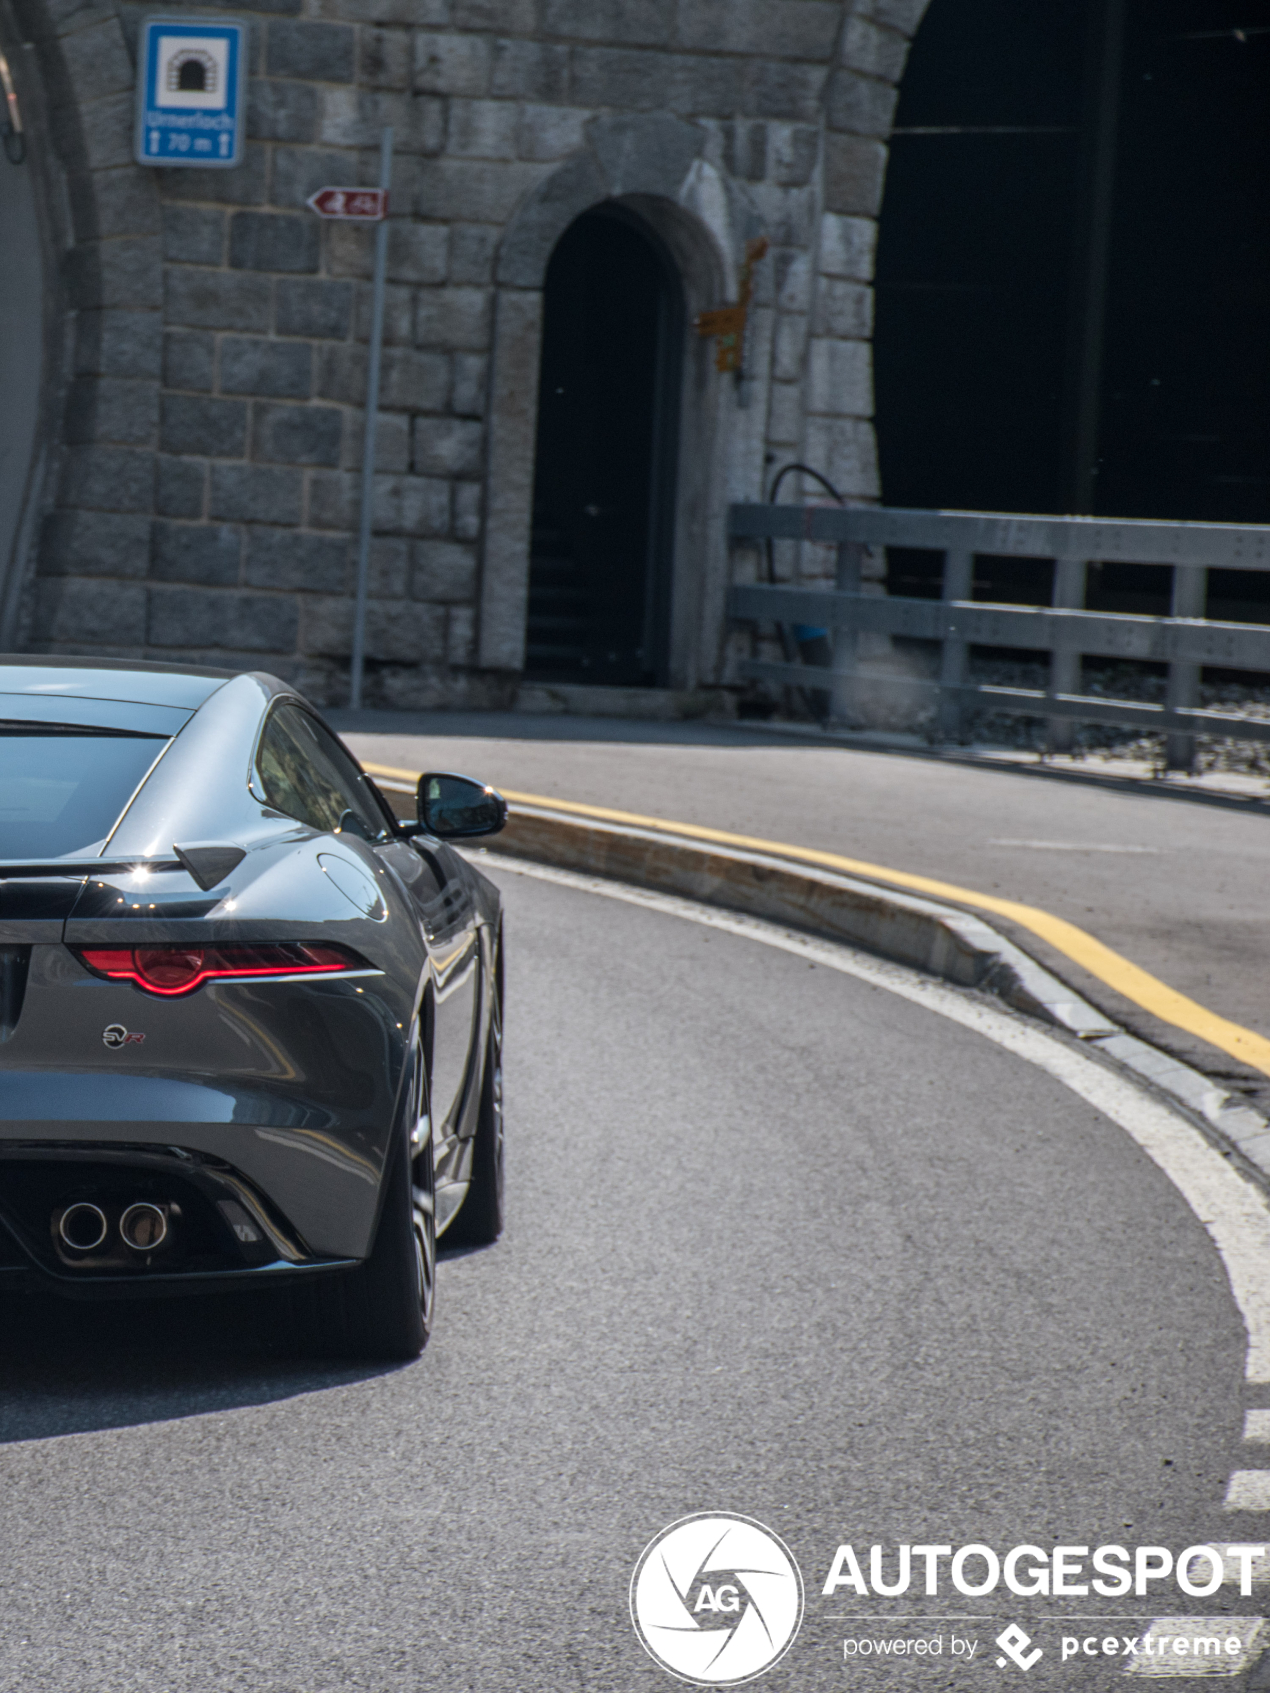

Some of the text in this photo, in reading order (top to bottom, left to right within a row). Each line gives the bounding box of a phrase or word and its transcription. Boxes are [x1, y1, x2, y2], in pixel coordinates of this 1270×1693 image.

[168, 132, 212, 152] 70 m
[102, 1028, 146, 1046] SVR
